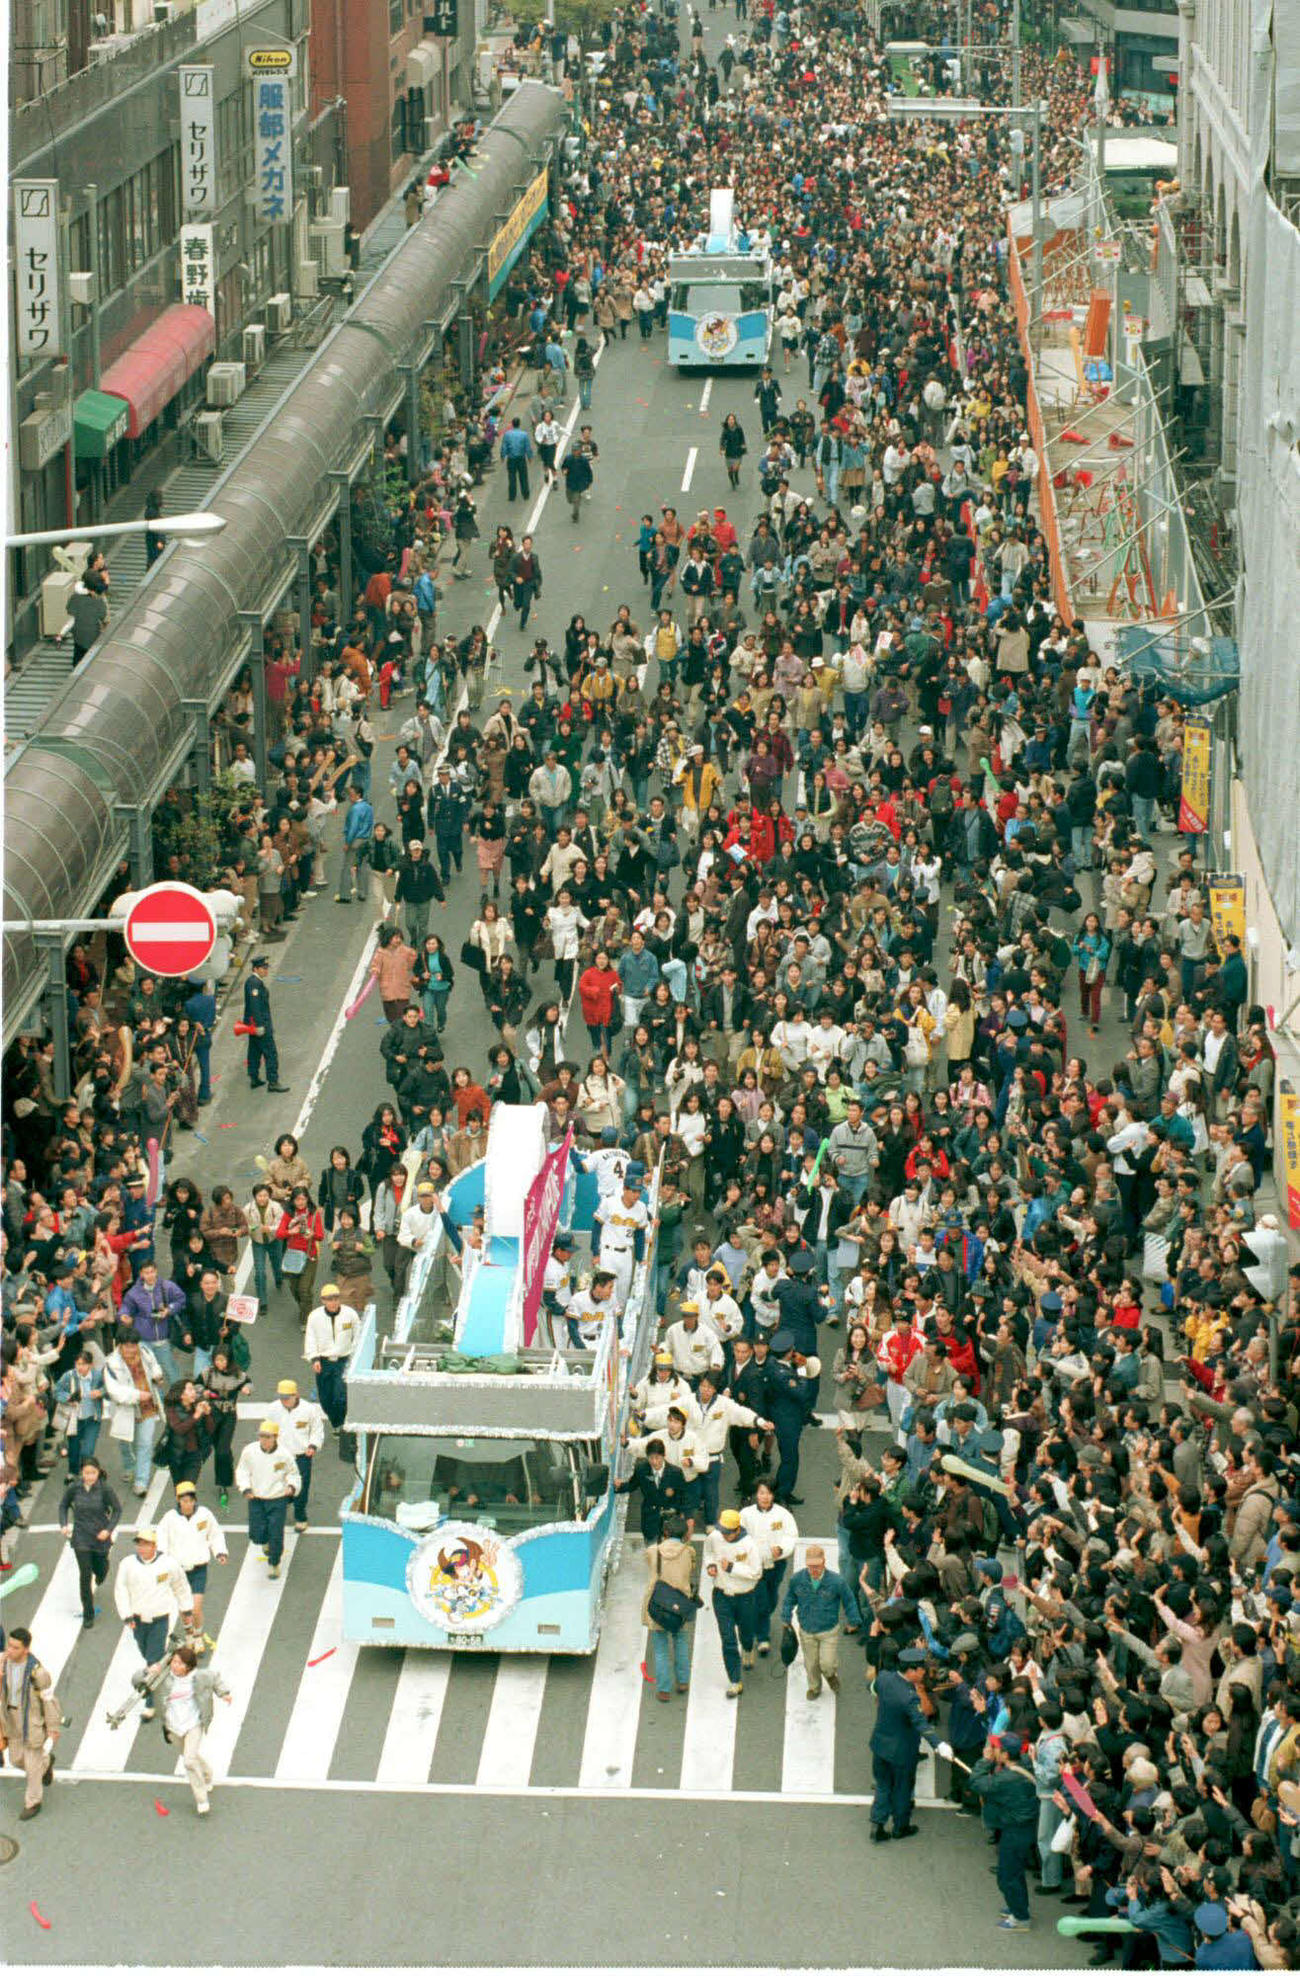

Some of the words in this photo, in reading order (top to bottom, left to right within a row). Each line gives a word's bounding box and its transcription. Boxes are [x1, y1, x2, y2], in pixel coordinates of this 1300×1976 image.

[254, 55, 288, 64] Nikon
[188, 121, 208, 205] セリザワ
[259, 83, 285, 221] 服部メガネ
[25, 247, 50, 351] セリザワ
[613, 1160, 624, 1178] 4
